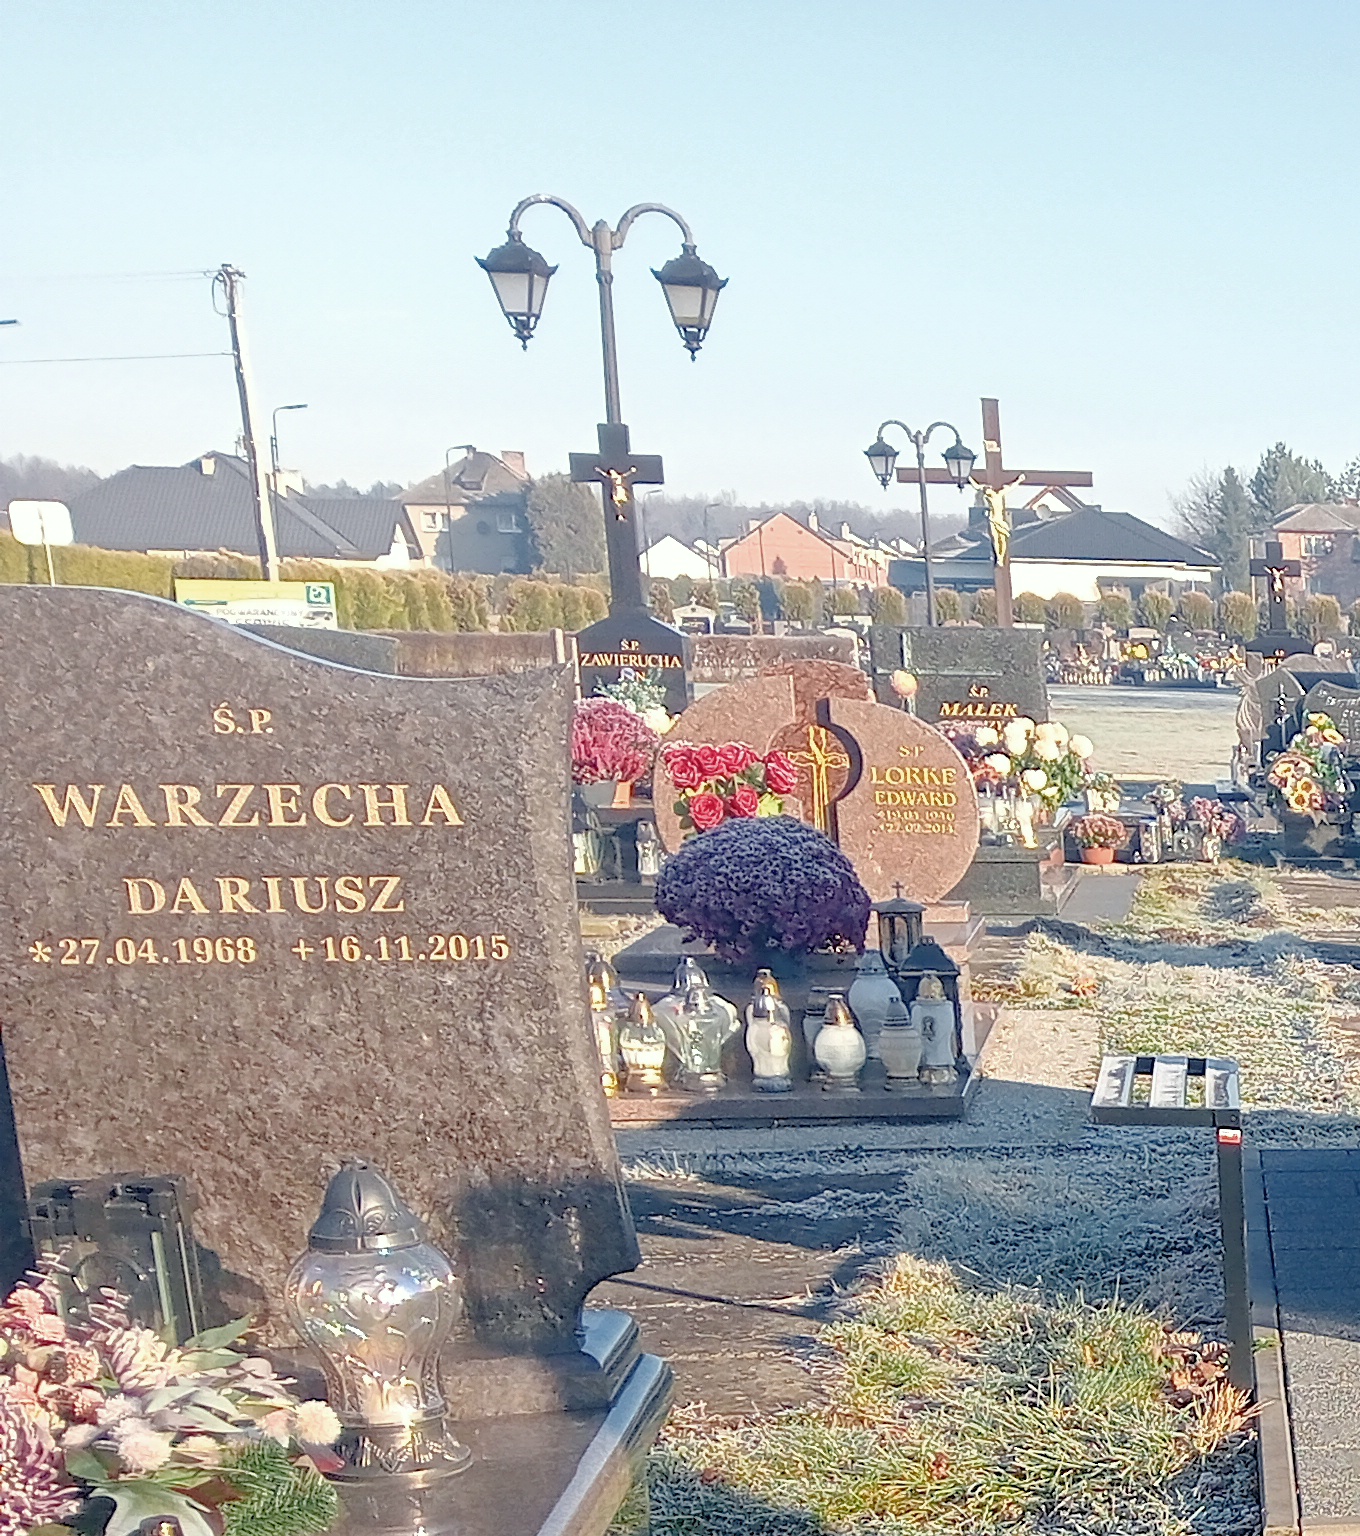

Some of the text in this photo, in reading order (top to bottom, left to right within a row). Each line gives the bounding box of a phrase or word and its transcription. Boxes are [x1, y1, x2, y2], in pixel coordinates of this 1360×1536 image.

[580, 653, 682, 668] ZAWIERUCHA
[213, 701, 274, 734] Ś.P.
[940, 703, 1018, 716] MAŁEK
[871, 767, 957, 786] LORKE
[32, 783, 464, 827] WARZECHA
[875, 791, 957, 807] EDWARD
[123, 876, 404, 914] DARIUSZ
